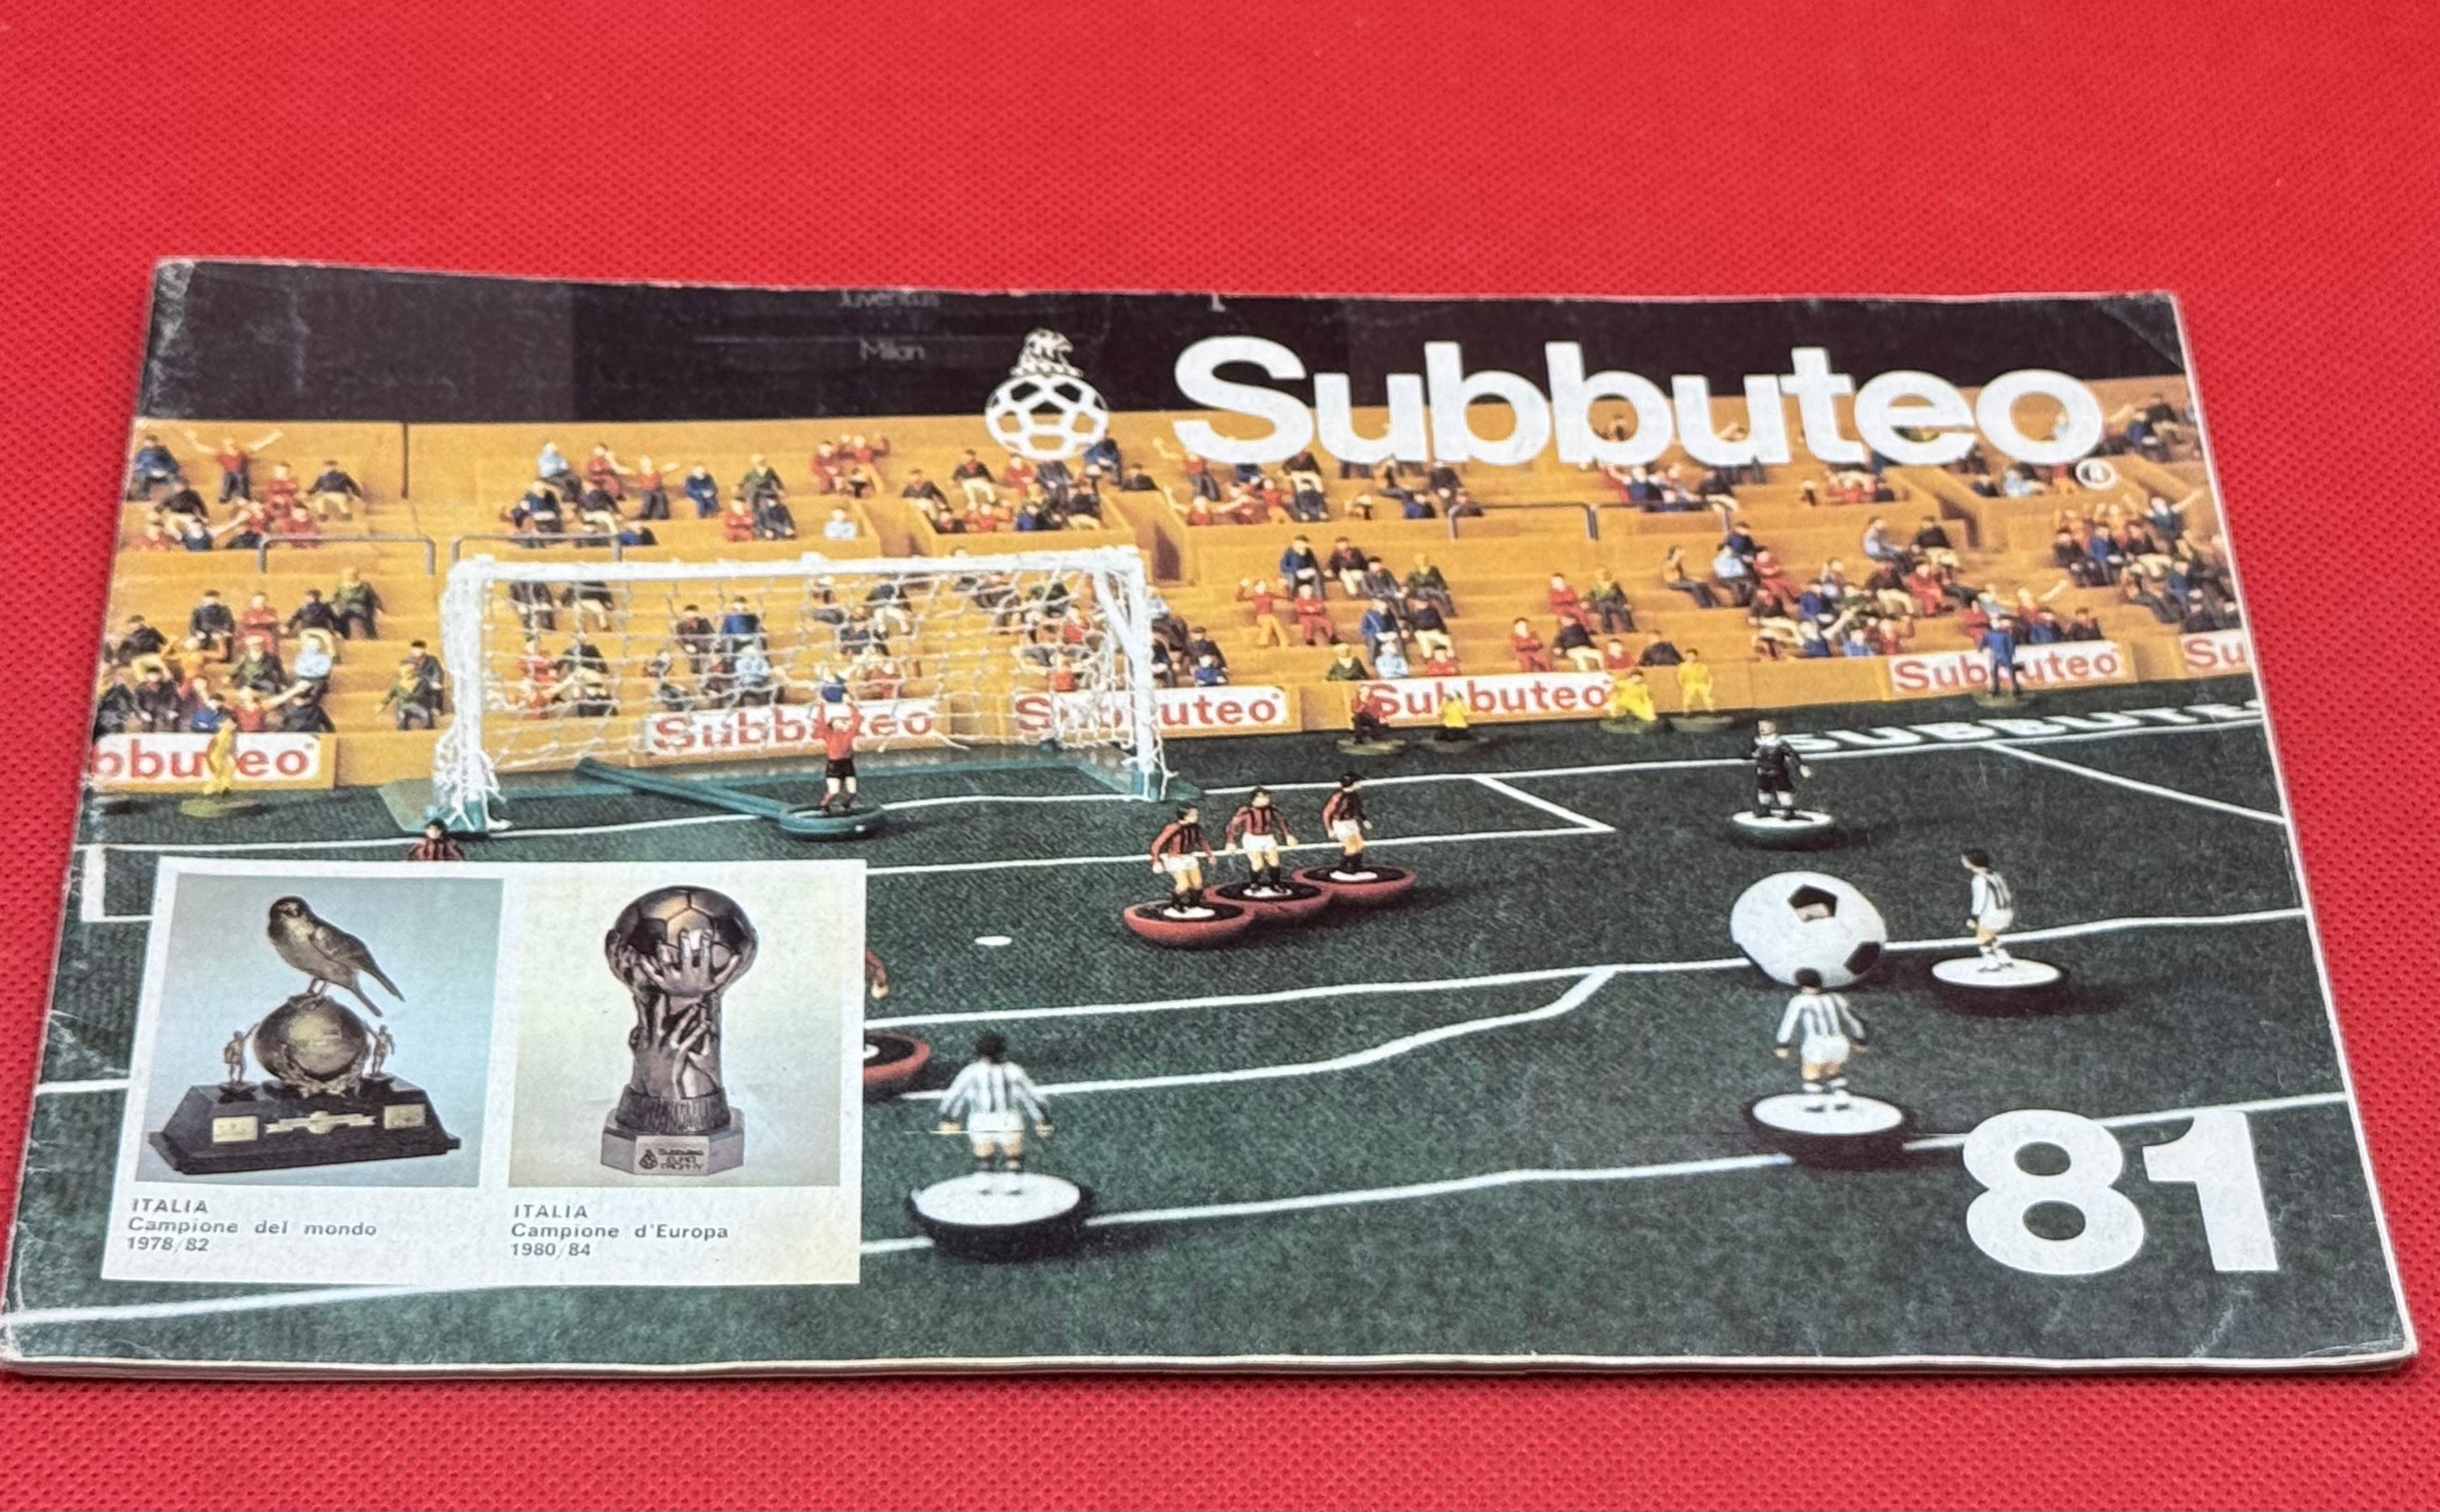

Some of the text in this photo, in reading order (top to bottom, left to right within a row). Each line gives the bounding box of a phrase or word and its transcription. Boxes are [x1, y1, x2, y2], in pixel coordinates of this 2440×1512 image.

[860, 336, 925, 361] Milan
[1173, 334, 2103, 466] Subbuteo
[1894, 650, 2118, 690] Subuteo
[654, 705, 934, 749] Subbeo
[1963, 1109, 2280, 1275] 81
[132, 1198, 208, 1213] ITALIA
[514, 1204, 588, 1218] ITALIA
[128, 1216, 377, 1236] Campione del mondo
[511, 1223, 728, 1242] Campione d'Europa
[127, 1237, 210, 1254] 1978/82
[510, 1242, 591, 1260] 1980/84
